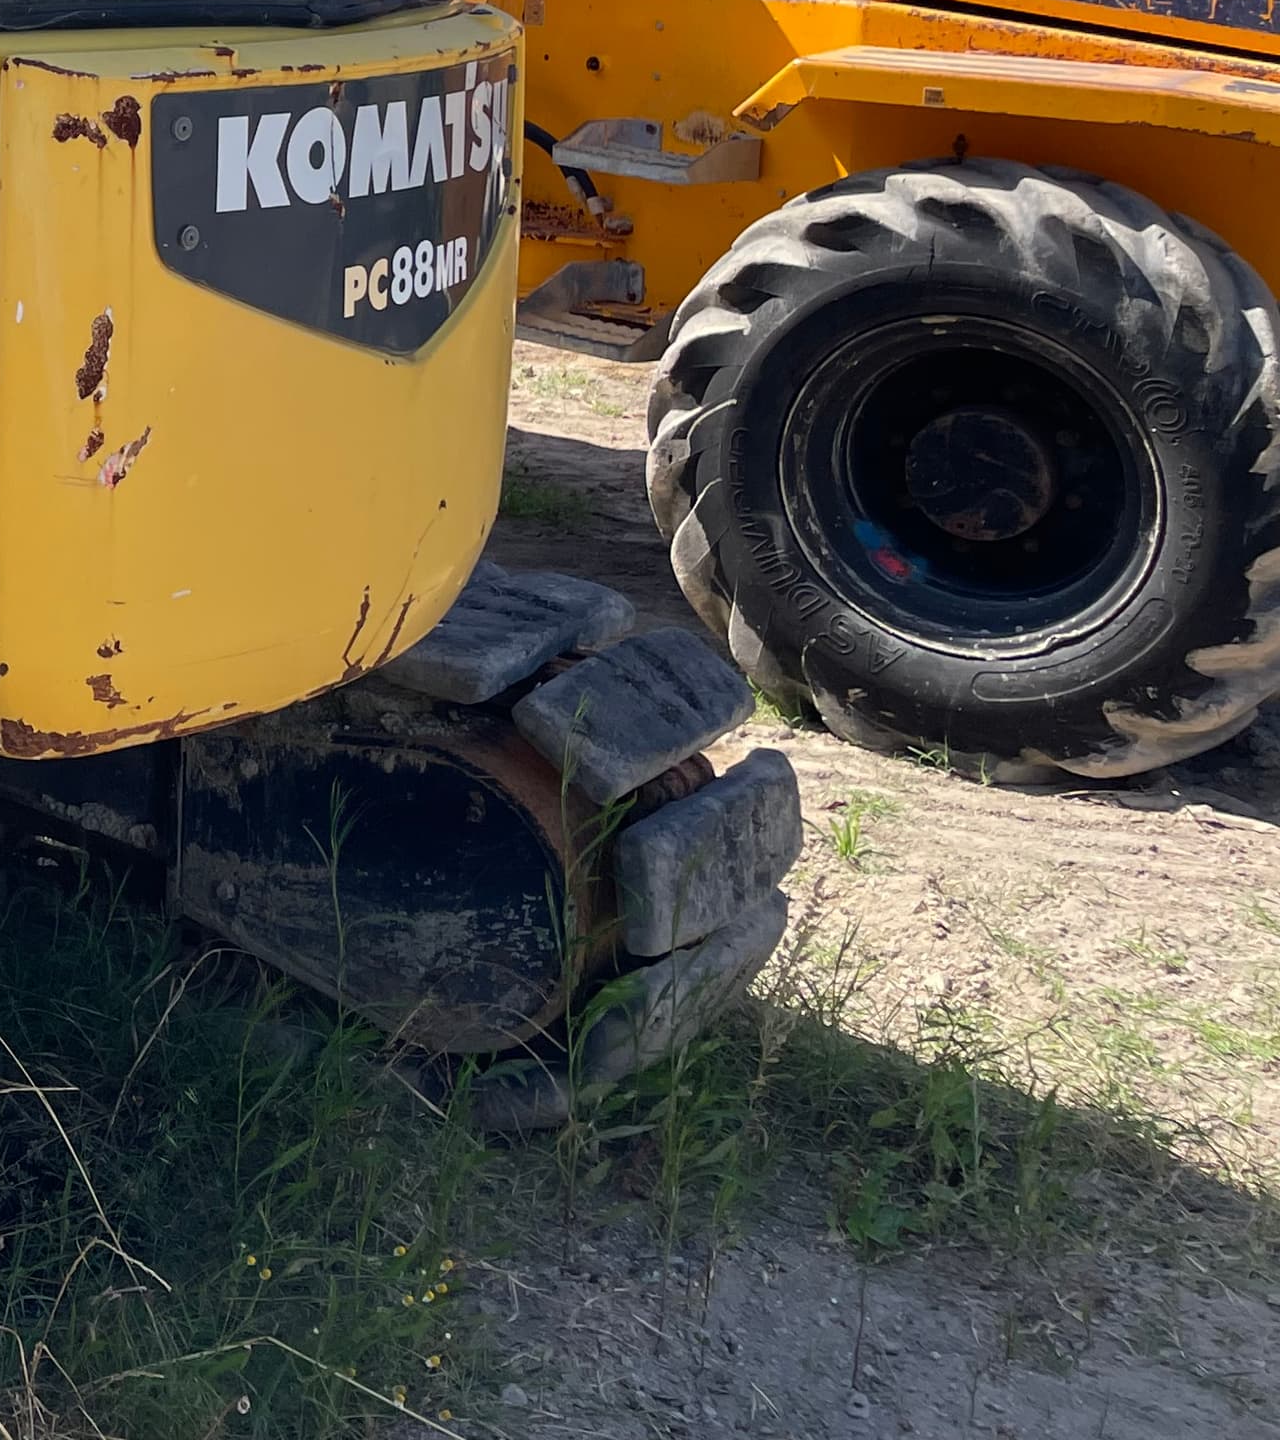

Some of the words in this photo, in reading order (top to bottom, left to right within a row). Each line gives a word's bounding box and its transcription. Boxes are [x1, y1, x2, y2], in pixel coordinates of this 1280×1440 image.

[216, 62, 509, 213] KOMATSU
[343, 237, 468, 318] PC88MR
[820, 613, 908, 675] AS
